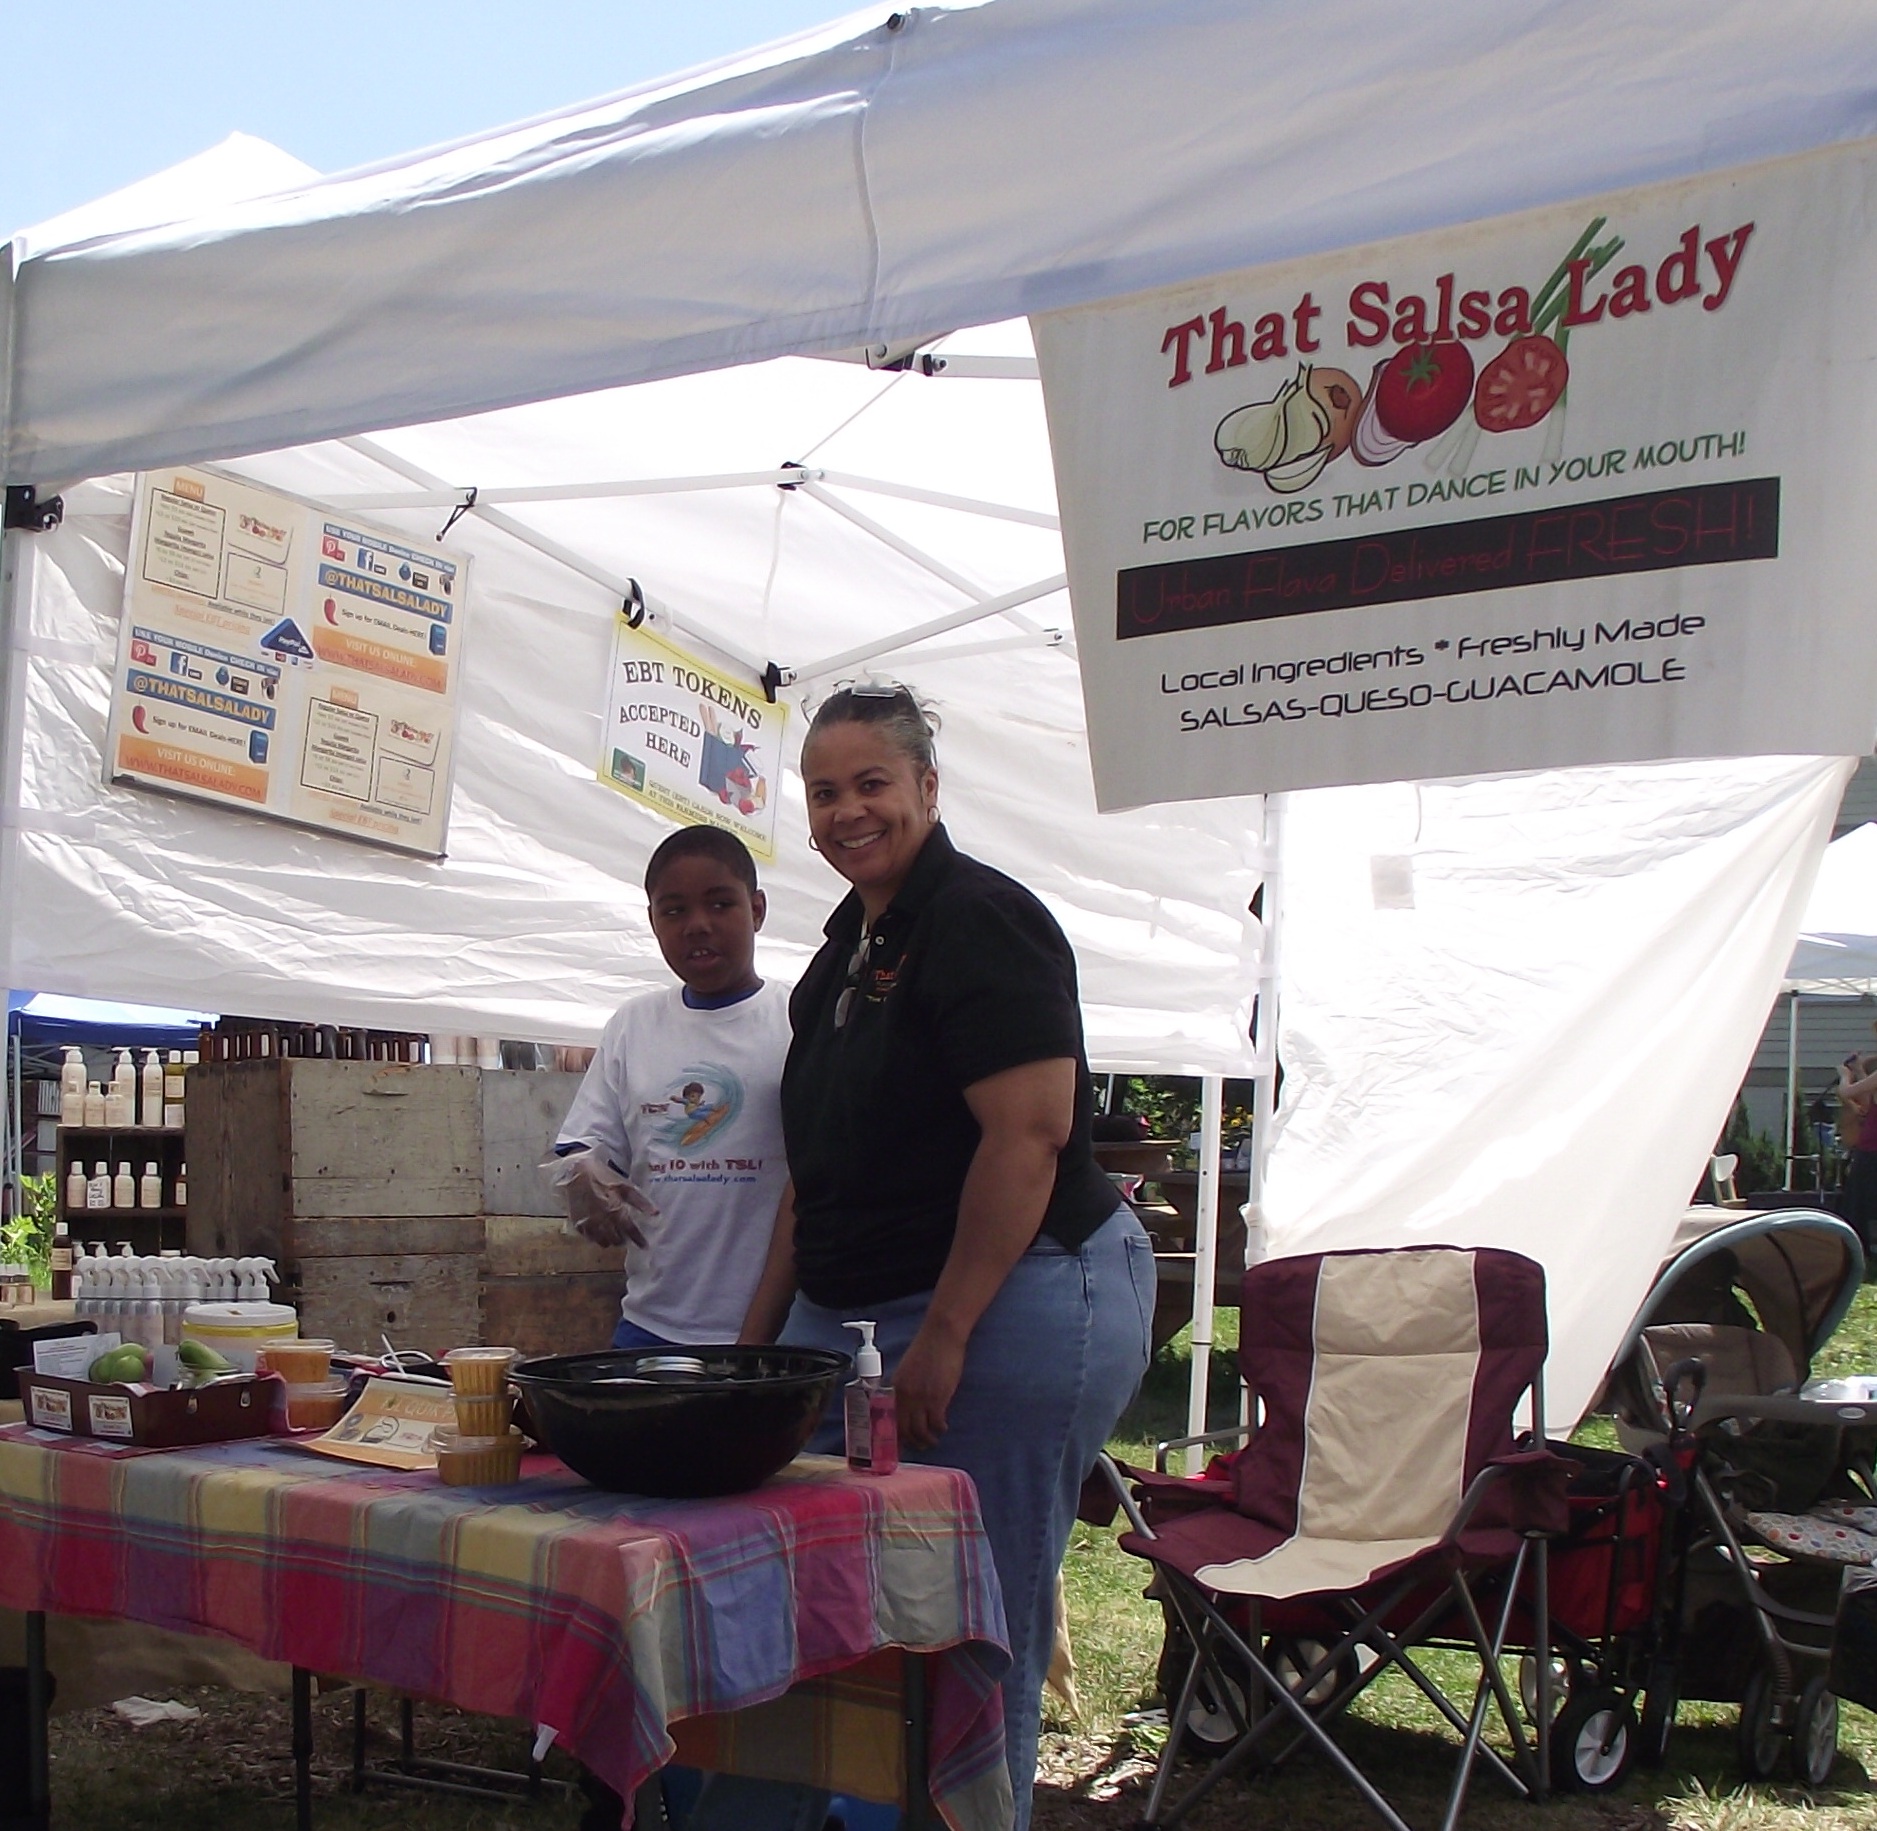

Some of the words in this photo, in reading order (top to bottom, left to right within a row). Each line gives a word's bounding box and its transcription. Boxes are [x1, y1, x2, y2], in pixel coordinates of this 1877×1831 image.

[1160, 291, 1322, 389] That
[1346, 272, 1533, 347] Salsa
[1561, 220, 1756, 328] Lady
[176, 480, 204, 497] MENU
[1143, 515, 1196, 543] FOR
[1203, 499, 1325, 536] FLAVORS
[1332, 486, 1401, 519] THAT
[1407, 469, 1507, 507] DANCE
[1514, 466, 1541, 491] IN
[1549, 449, 1628, 485] YOUR
[1633, 431, 1746, 470] MOUTH!
[342, 529, 361, 541] YOUR
[1132, 569, 1231, 625] Urban
[1244, 556, 1339, 607] Flava
[1351, 523, 1515, 596] Delivered
[1527, 491, 1755, 571] FRESH!
[325, 569, 448, 618] @THATSALSALADY
[134, 627, 151, 639] USE
[153, 633, 174, 645] YOUR
[176, 639, 203, 653] MOBILE
[346, 639, 368, 653] VISIT
[369, 645, 381, 657] US
[1161, 664, 1244, 694] Local
[1251, 645, 1425, 684] Ingredients
[1457, 626, 1585, 660] Freshly
[1595, 613, 1706, 645] Made
[133, 675, 270, 724] @THATSALSALADY
[623, 661, 665, 684] EBT
[673, 666, 763, 730] TOKENS
[1180, 658, 1686, 732] SALSAS-QUESO-GUACAMOLE
[153, 716, 167, 728] Sign
[167, 721, 176, 730] up
[178, 722, 187, 731] for
[619, 704, 701, 739] ACCEPTED
[157, 748, 182, 763] VISIT
[185, 754, 198, 765] US
[646, 732, 691, 769] HERE
[126, 755, 261, 798] WWW.THATSALSALADY.COM
[669, 1159, 686, 1171] 10
[690, 1159, 720, 1171] with
[725, 1159, 763, 1171] TSL!
